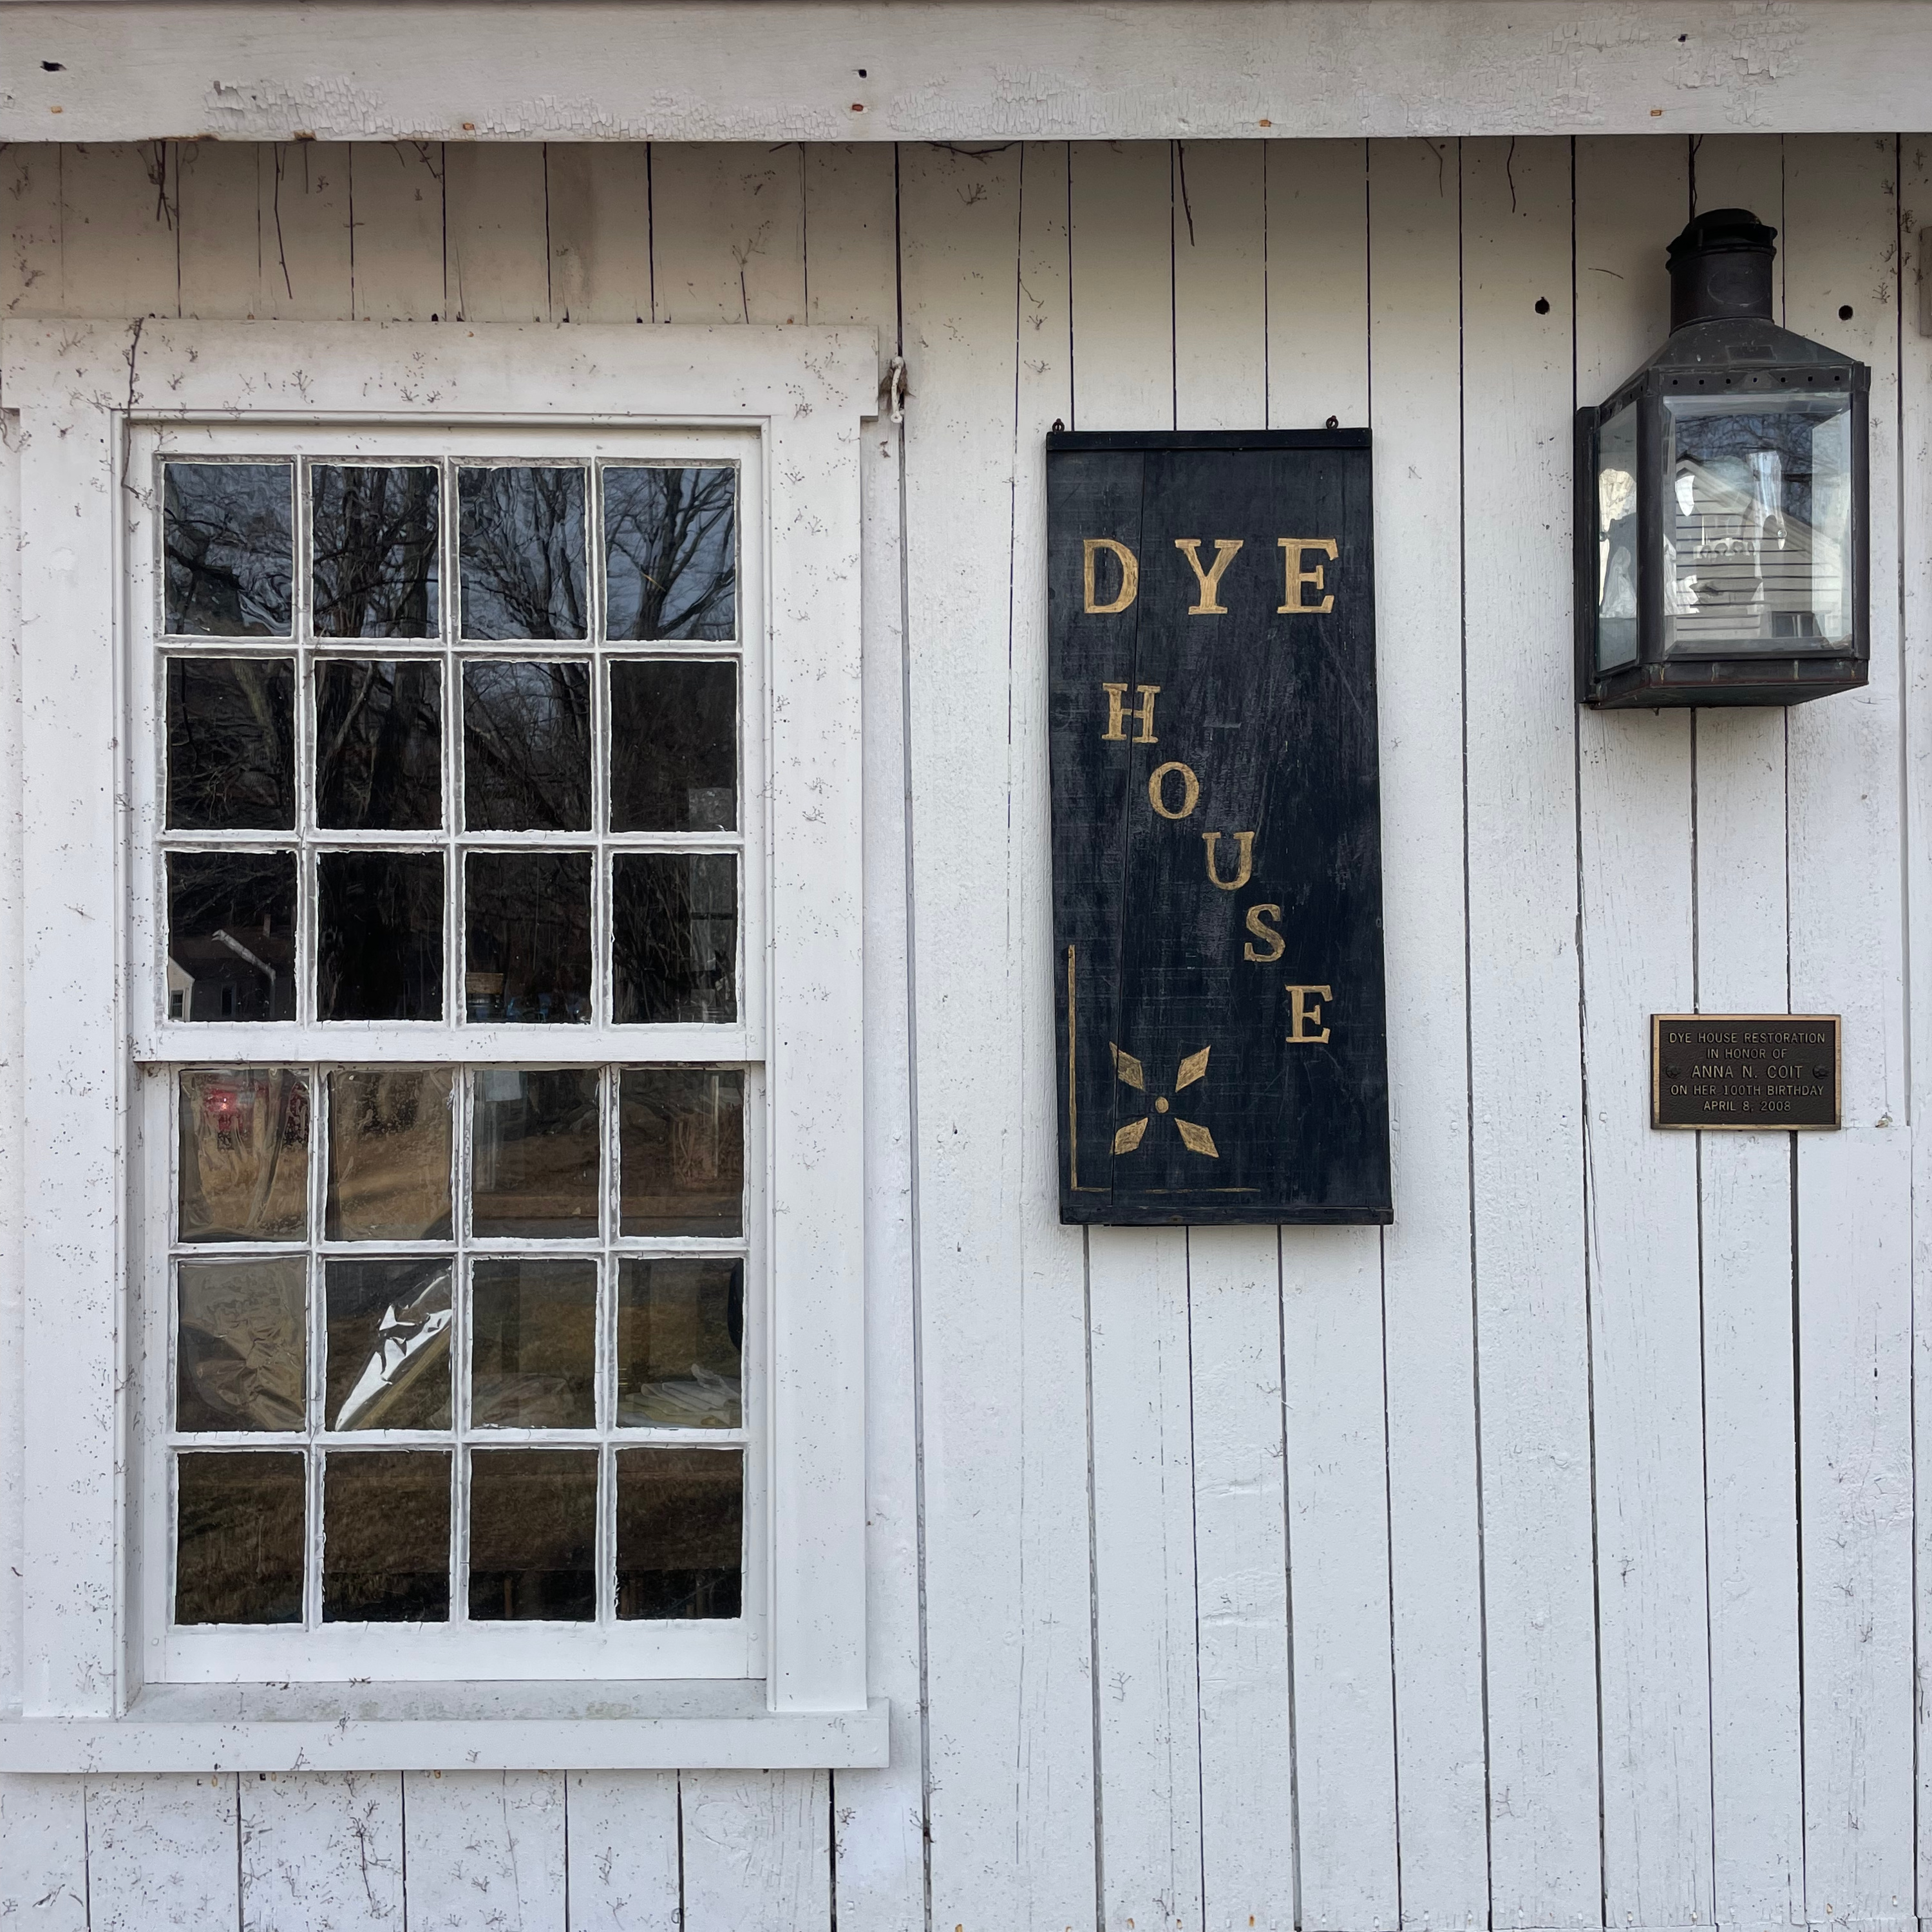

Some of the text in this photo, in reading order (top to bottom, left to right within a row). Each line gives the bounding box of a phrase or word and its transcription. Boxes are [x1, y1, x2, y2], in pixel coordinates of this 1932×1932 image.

[1083, 538, 1338, 615] DYE
[1102, 683, 1334, 1044] HOUSE
[1669, 1033, 1825, 1043] DYE HOUSE RESTORATION
[1707, 1048, 1788, 1059] IN HONOR OF
[1691, 1065, 1803, 1079] ANNA N. COIT
[1671, 1085, 1824, 1095] ON HER 100TH BIRTHDAY
[1703, 1101, 1791, 1112] APRIL 8, 2008
